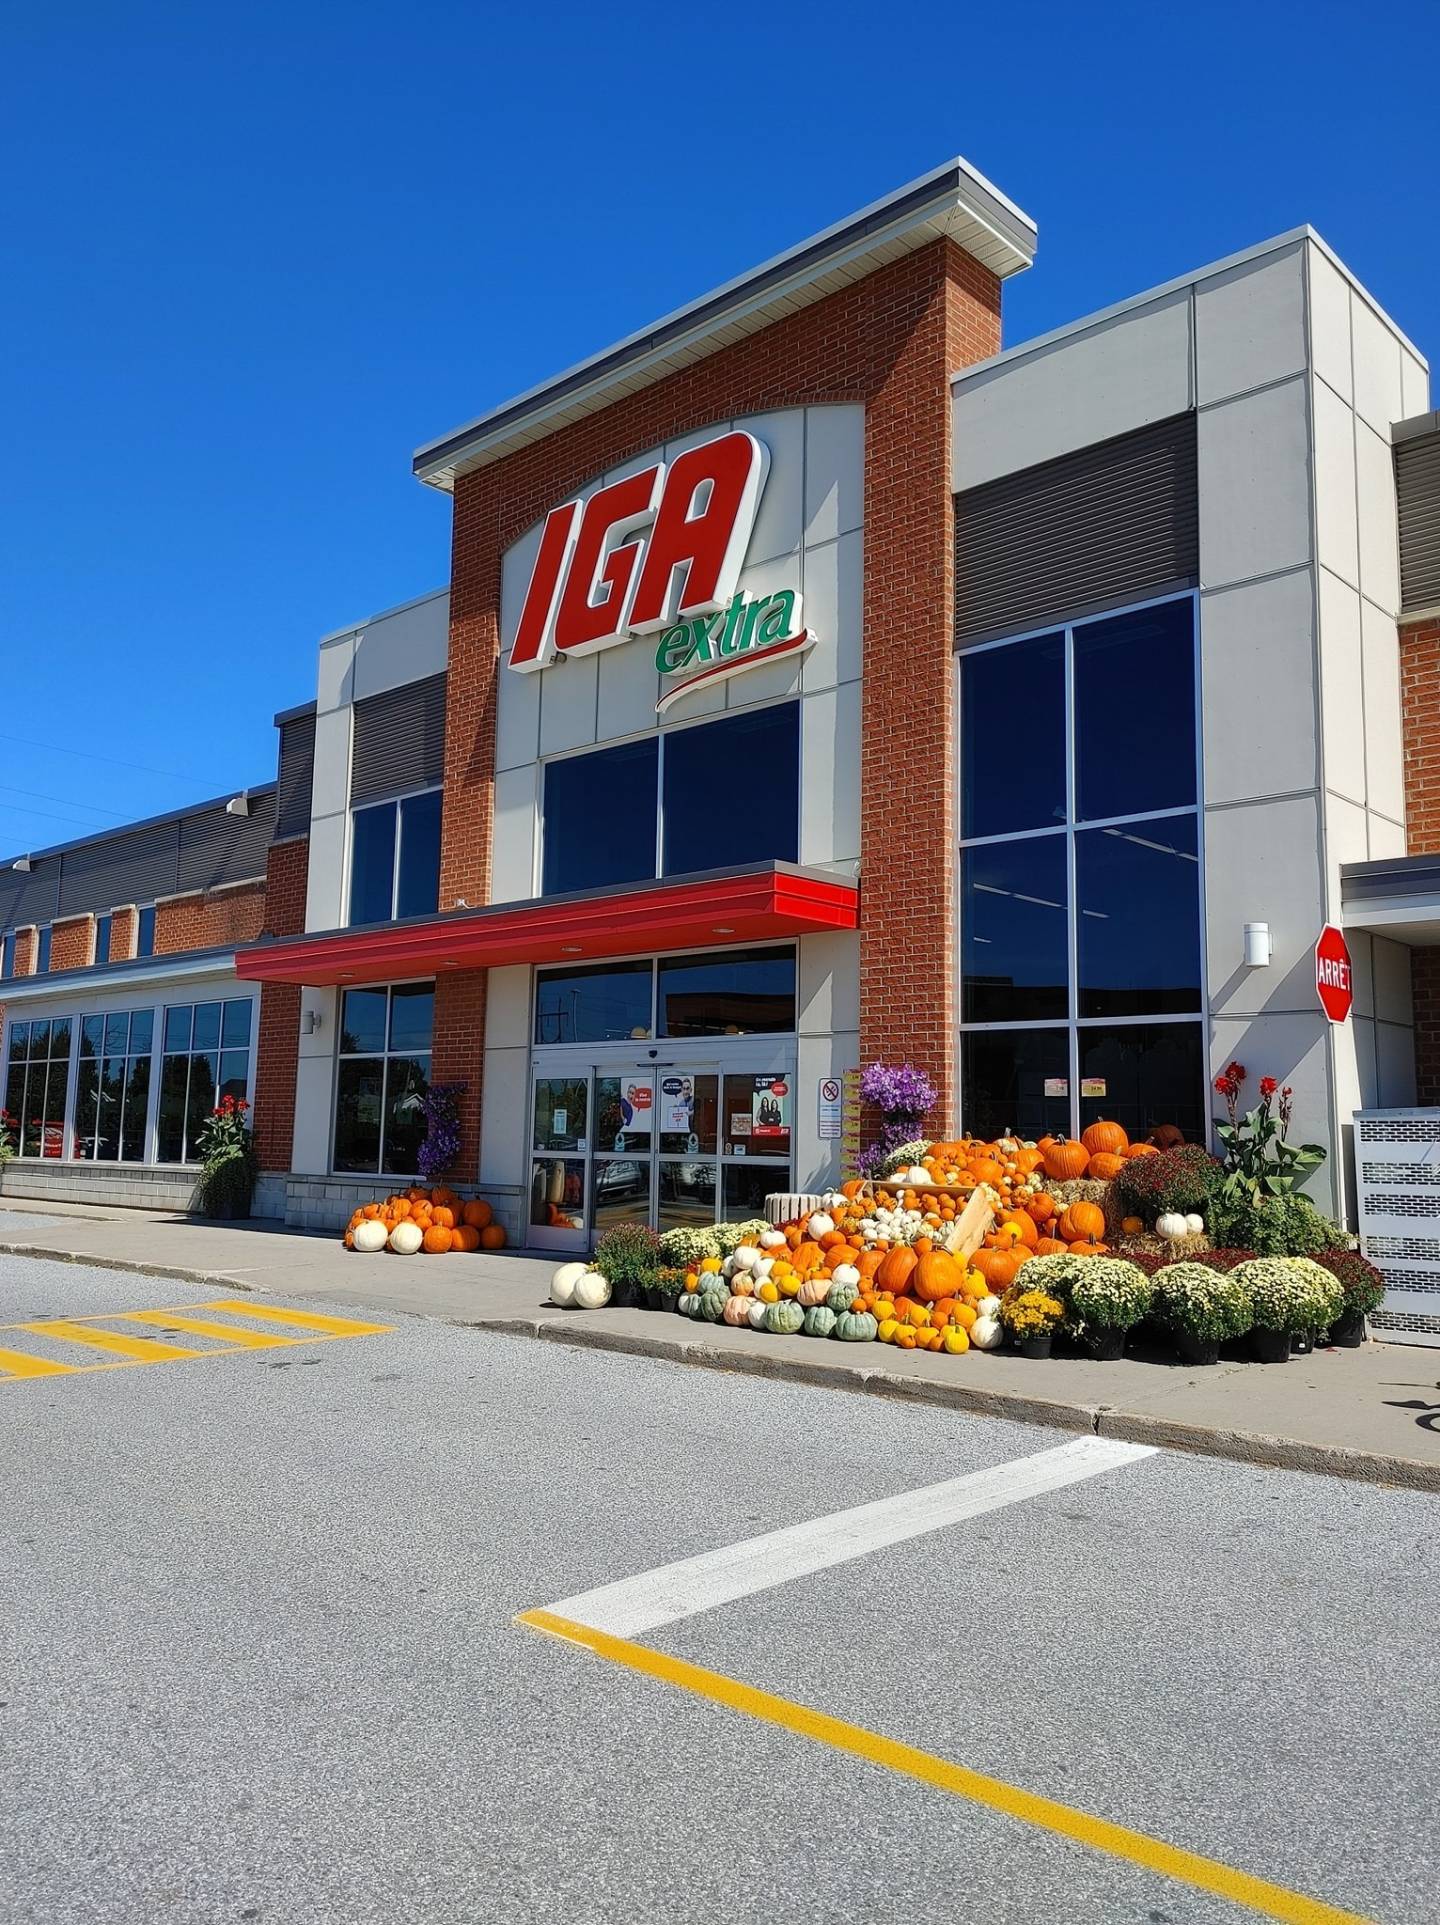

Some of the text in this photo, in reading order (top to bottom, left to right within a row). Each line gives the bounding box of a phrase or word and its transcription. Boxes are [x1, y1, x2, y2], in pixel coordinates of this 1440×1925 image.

[508, 430, 764, 672] IGA
[655, 588, 802, 675] extra
[1318, 957, 1351, 991] ARRÊT
